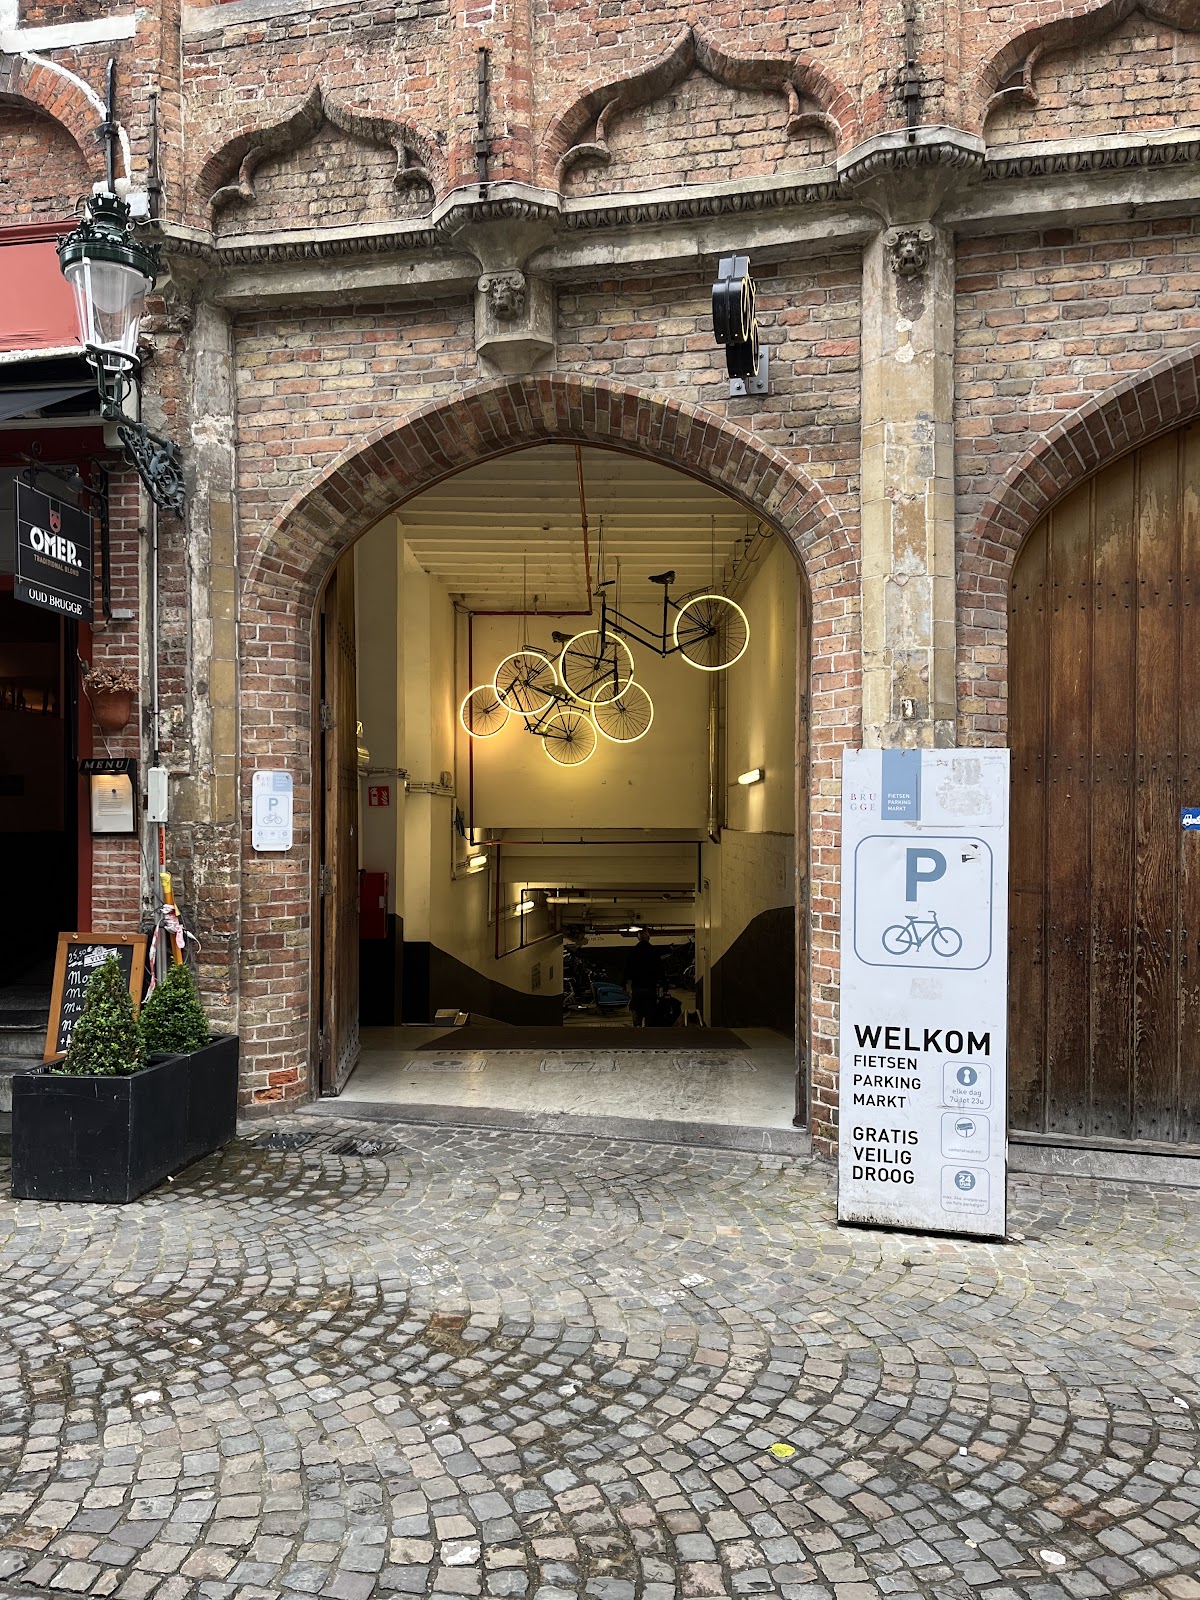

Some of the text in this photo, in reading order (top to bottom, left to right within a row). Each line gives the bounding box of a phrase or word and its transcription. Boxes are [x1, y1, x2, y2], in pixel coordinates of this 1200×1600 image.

[30, 526, 83, 568] OMER.
[33, 553, 80, 577] TRADITIONAL BLOND
[28, 588, 83, 616] OUD BRUGGE
[84, 760, 125, 769] MENU
[268, 797, 279, 811] P
[850, 793, 877, 801] BRU
[850, 802, 876, 811] GGE
[905, 847, 947, 902] P
[854, 1024, 991, 1056] WELKOM
[853, 1054, 918, 1071] FIETSEN
[853, 1074, 922, 1090] PARKING
[853, 1093, 907, 1109] MARKT
[968, 1089, 982, 1097] dag
[971, 1097, 985, 1105] 23u
[853, 1126, 919, 1145] GRATIS
[853, 1146, 912, 1165] VEILIG
[852, 1166, 915, 1184] DROOG
